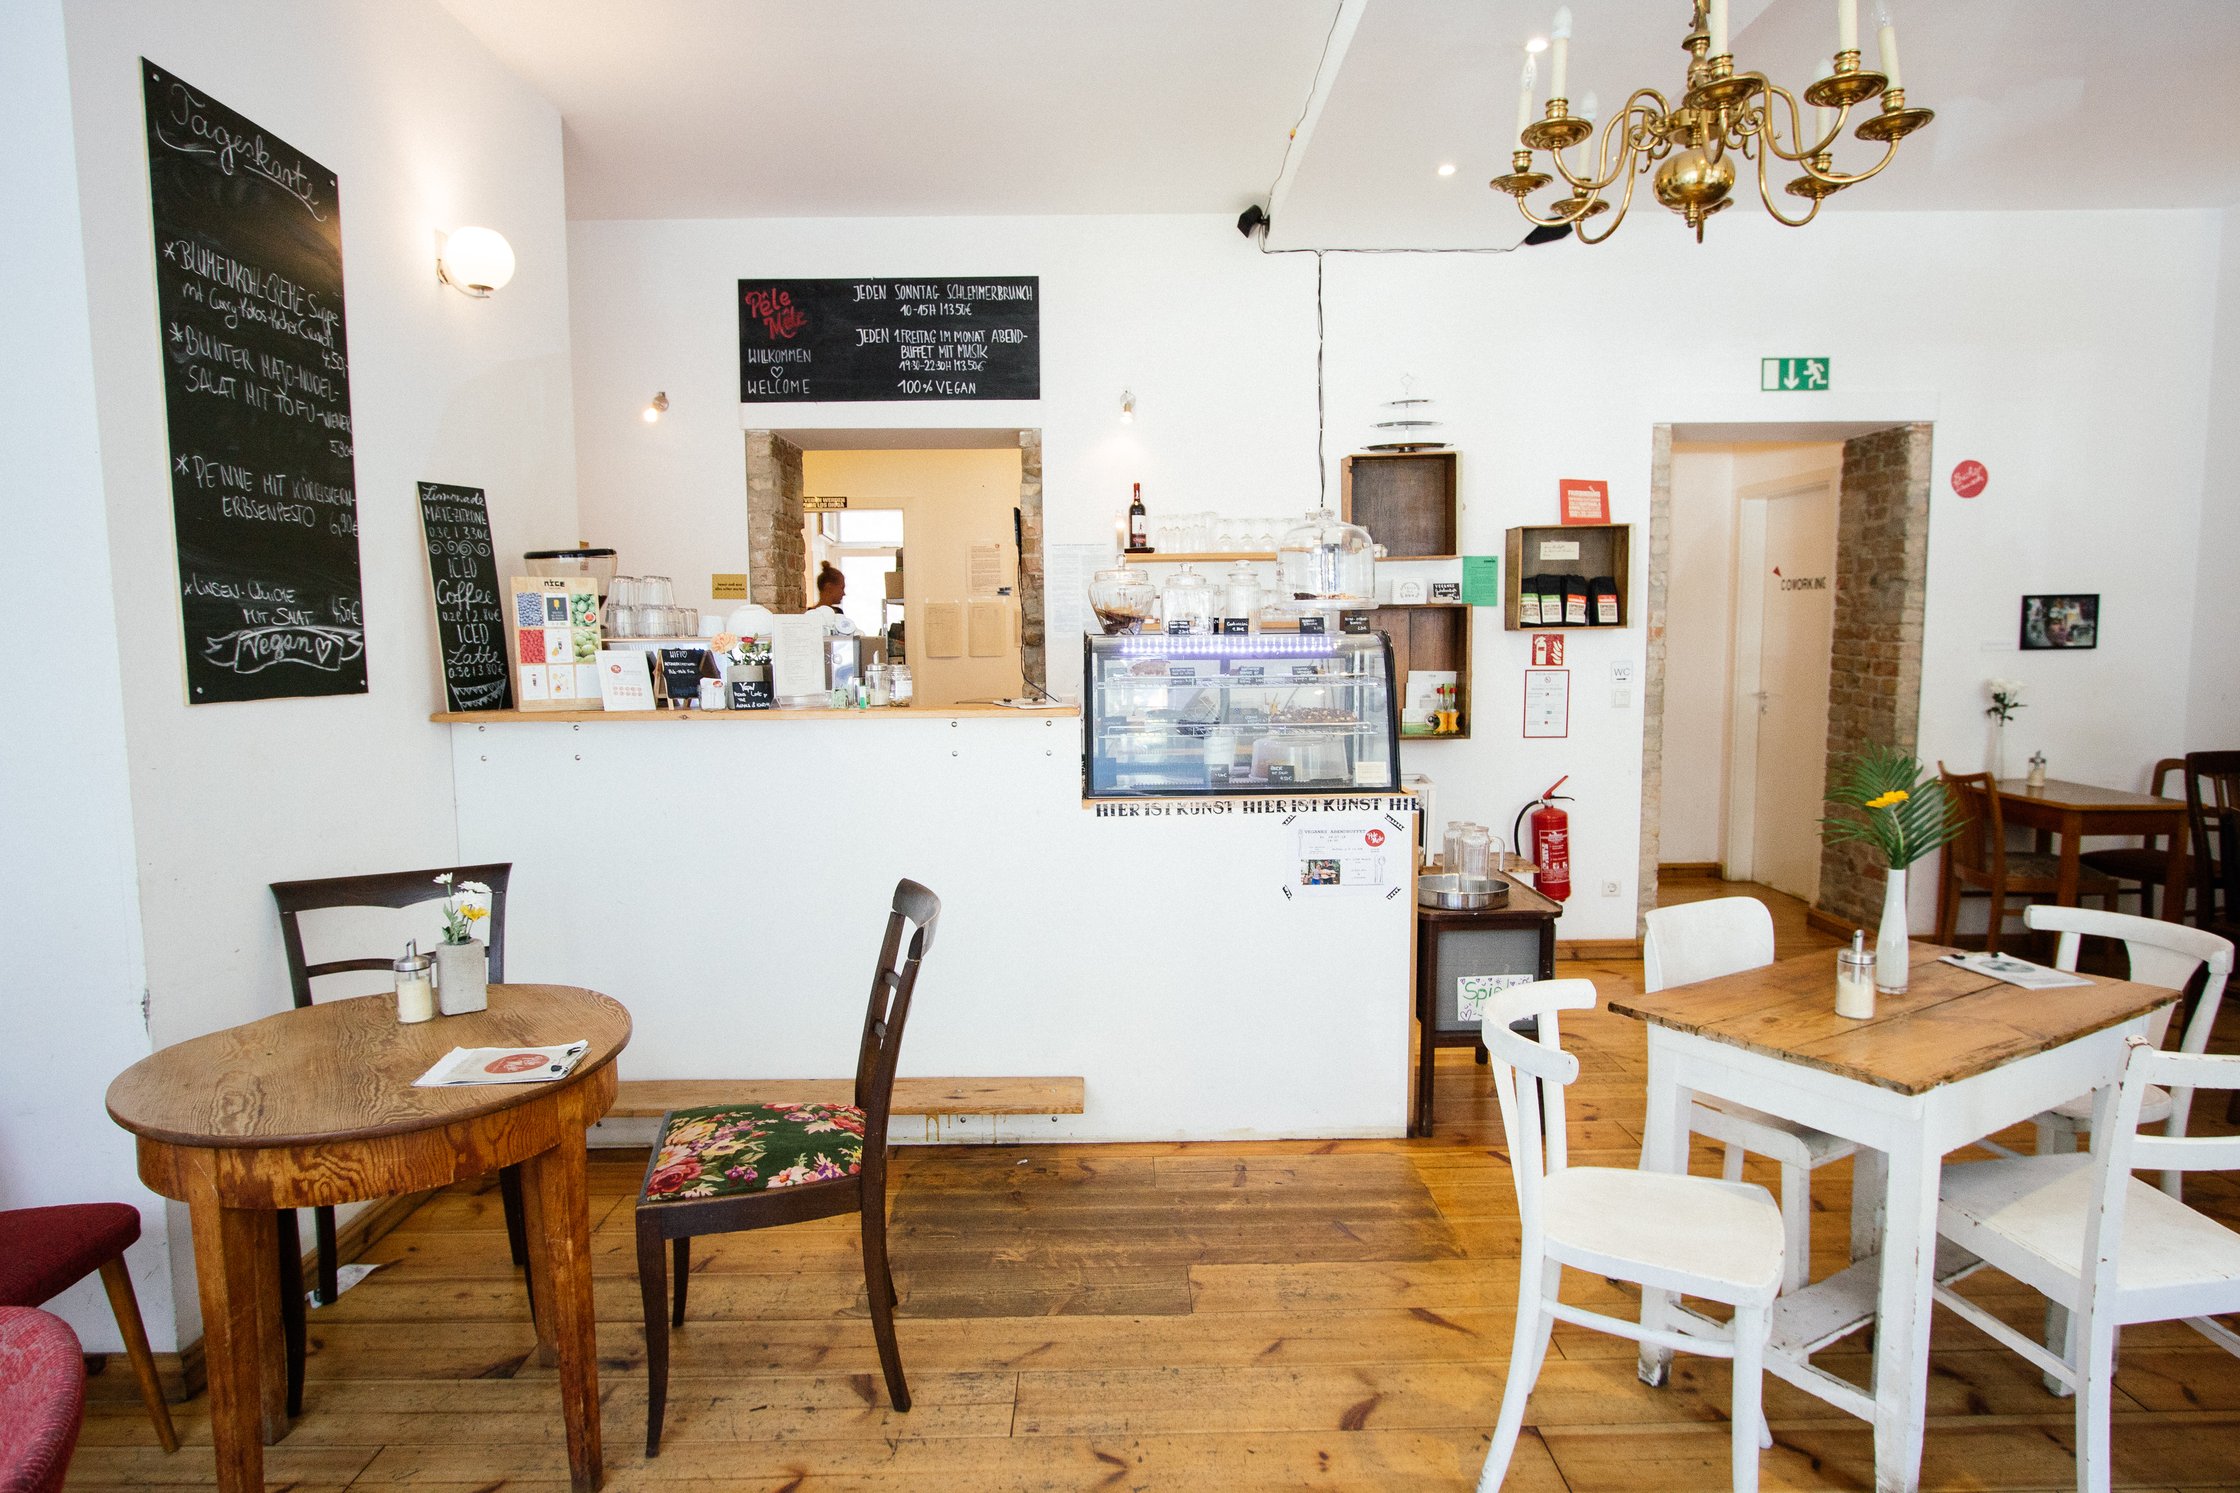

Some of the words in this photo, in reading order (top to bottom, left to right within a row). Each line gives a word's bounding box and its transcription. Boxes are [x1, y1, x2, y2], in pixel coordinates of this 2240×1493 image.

[171, 83, 319, 205] Tageskarte
[853, 284, 887, 302] JEDEN
[894, 284, 940, 300] SONNTAG
[946, 283, 1033, 301] SCHLEMMERBRUNCH
[855, 328, 890, 347] JEDEN
[939, 330, 951, 343] IM
[953, 330, 986, 343] MONAT
[991, 329, 1028, 344] ABEND-
[185, 325, 256, 373] BUNTER
[747, 348, 812, 364] WILLKOMMEN
[901, 345, 934, 359] BUFFET
[938, 345, 953, 359] MIT
[957, 344, 988, 359] MUSIK
[185, 365, 237, 400] SALAT
[747, 379, 811, 394] WELCOME
[936, 381, 976, 394] VEGAN
[192, 455, 254, 492] PENNE
[221, 496, 316, 528] ERBSENPESTO
[447, 556, 478, 578] ICED
[437, 579, 497, 611] Coffee
[457, 623, 489, 645] ICED
[242, 633, 314, 661] Vegan
[447, 644, 501, 666] Latte
[1613, 667, 1631, 676] WC
[1096, 803, 1140, 817] HIER
[1176, 800, 1233, 816] KUNST
[1242, 799, 1287, 814] HIER
[1291, 798, 1321, 812] IST
[1323, 797, 1382, 812] KUNST
